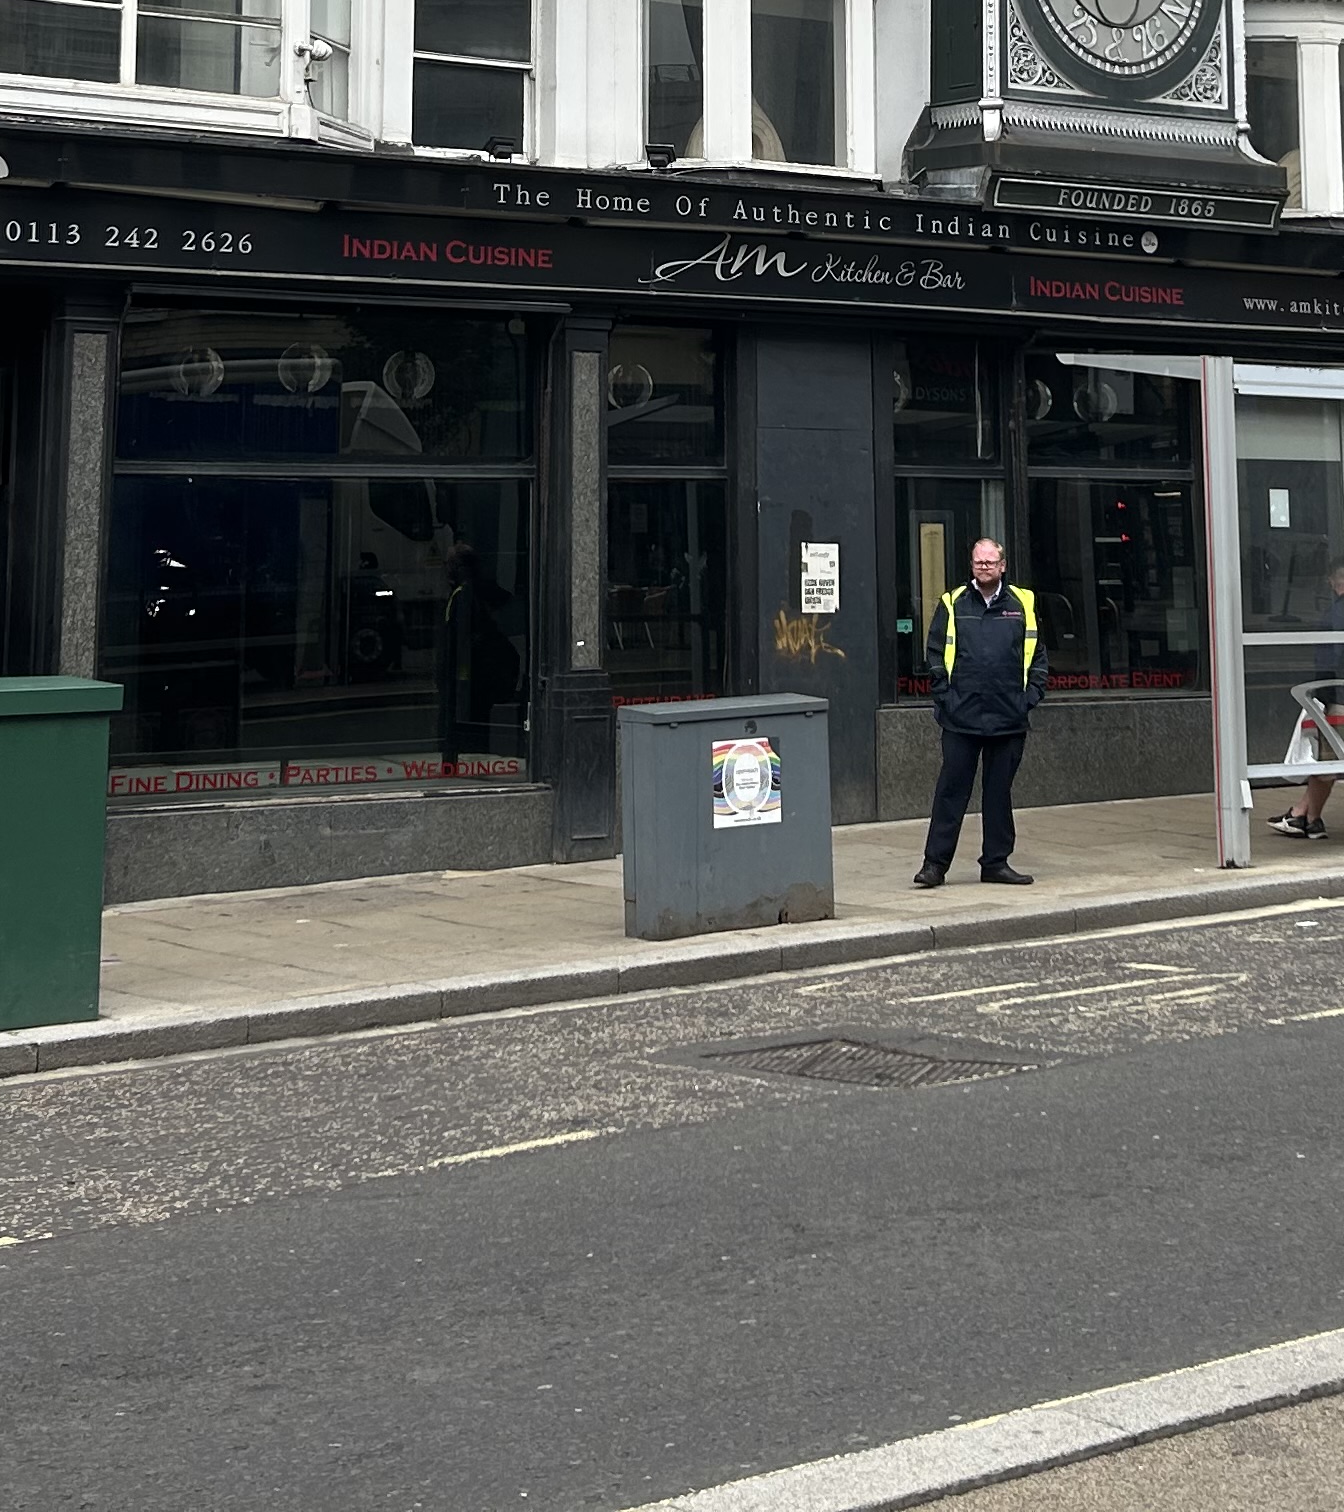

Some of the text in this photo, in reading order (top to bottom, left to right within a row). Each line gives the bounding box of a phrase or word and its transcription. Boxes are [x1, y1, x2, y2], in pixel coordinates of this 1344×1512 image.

[492, 183, 1135, 249] The Home Of Authentic Indian Cuisine
[1058, 187, 1217, 218] FOUNDED 1865
[5, 220, 83, 246] 0113
[104, 225, 160, 250] 242
[181, 230, 254, 255] 2626
[341, 234, 554, 271] INDIAN CUISINE
[638, 232, 966, 290] Am Kitchen & Bar
[1028, 276, 1184, 306] INDIAN CUISINE
[1046, 673, 1129, 691] ORPORATE
[110, 758, 520, 795] FINE DINING PARTIES WEDDINGS
